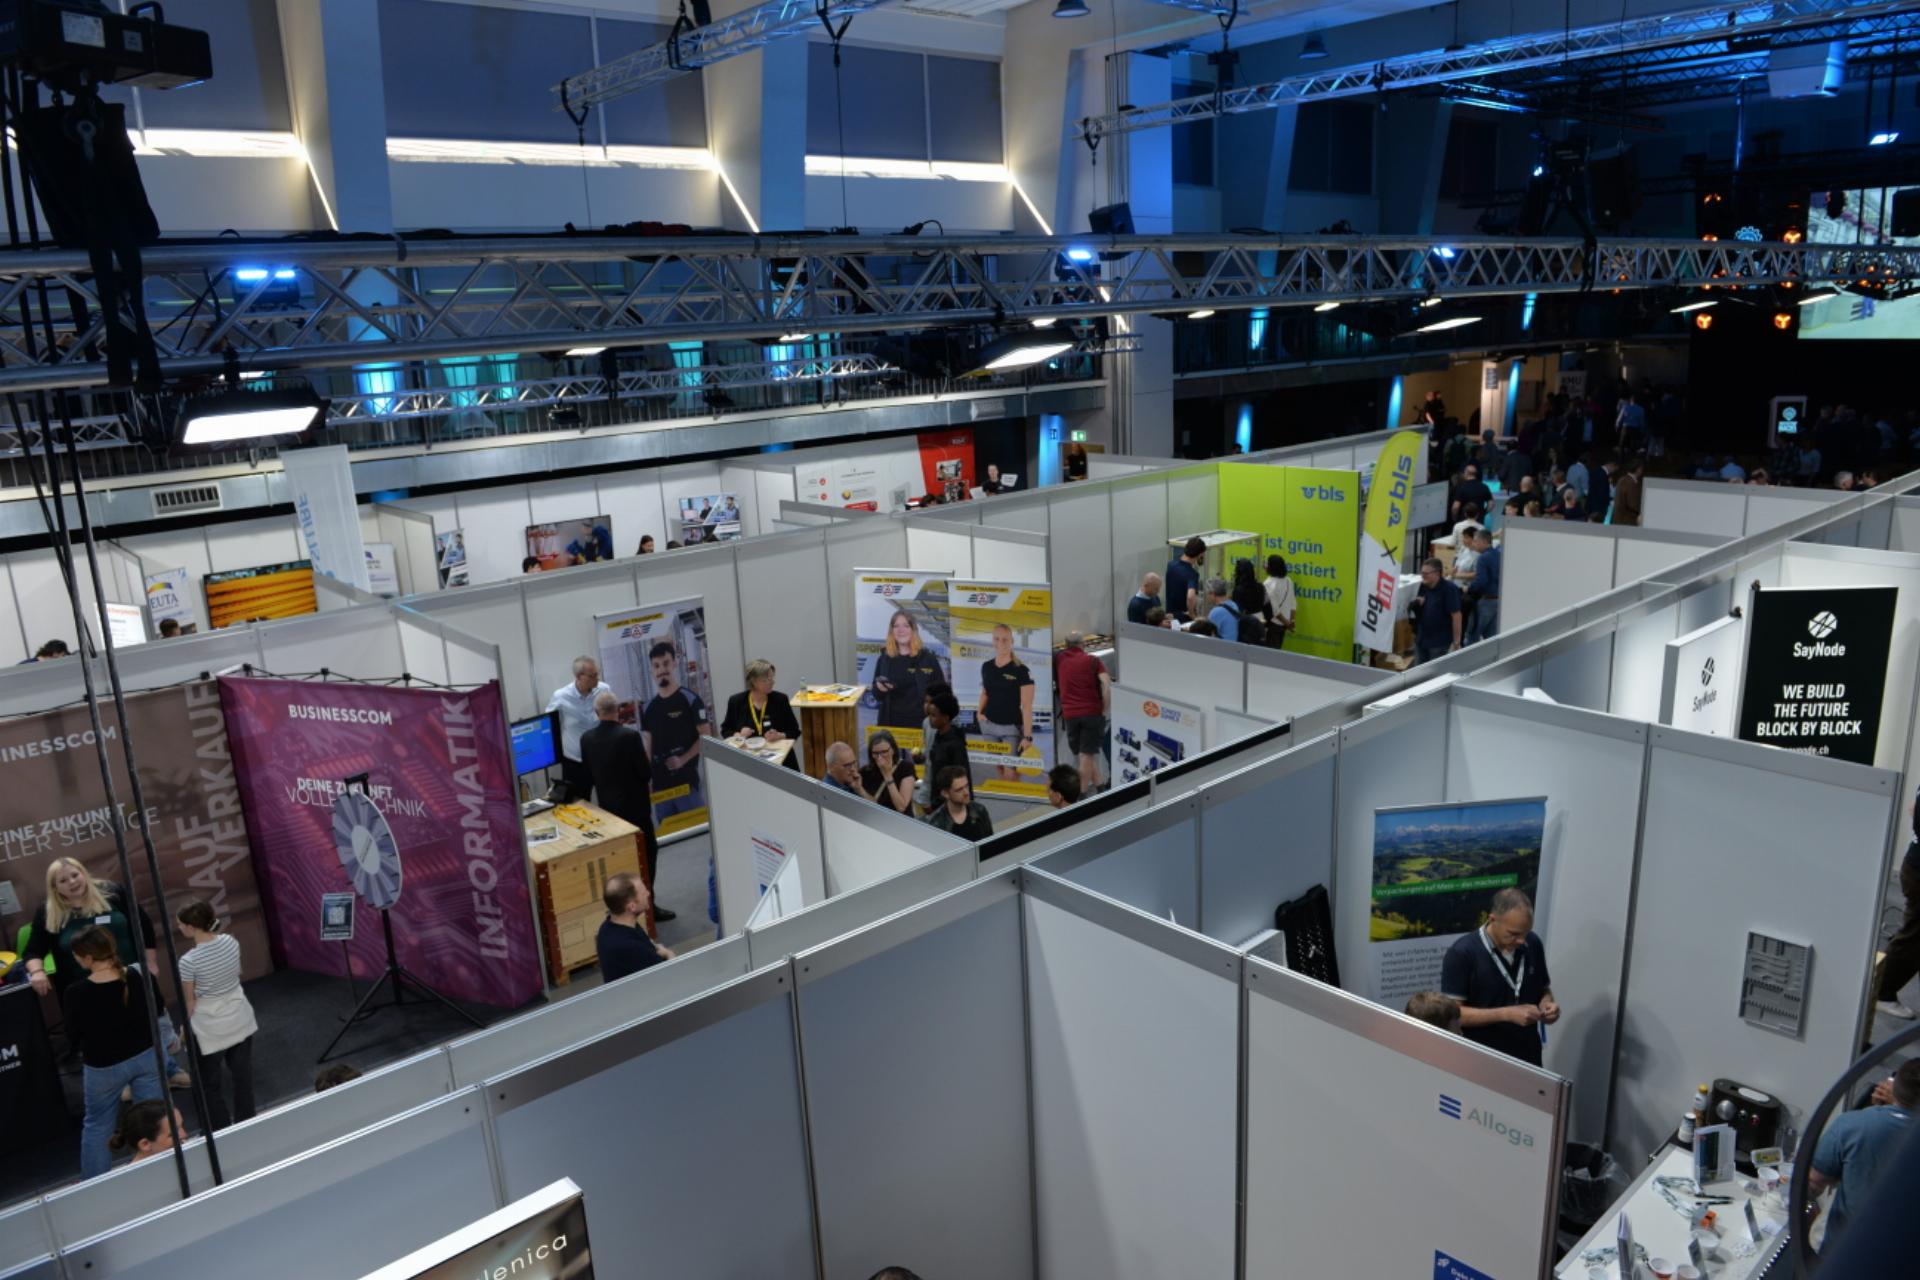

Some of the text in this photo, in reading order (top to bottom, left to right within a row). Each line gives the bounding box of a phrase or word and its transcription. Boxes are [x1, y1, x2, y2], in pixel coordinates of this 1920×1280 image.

[1389, 455, 1412, 500] bls
[1318, 485, 1345, 502] bls
[1265, 534, 1282, 549] ist
[1288, 539, 1323, 555] grün
[1294, 584, 1342, 603] kunft?
[1792, 641, 1846, 660] SayNode
[1782, 684, 1846, 699] WE BUILD
[288, 704, 393, 726] BUSINESSCOM
[1774, 702, 1850, 718] THE FUTURE
[1757, 720, 1862, 737] BLOCK BY BLOCK
[297, 777, 335, 793] DEINE
[285, 786, 336, 807] VOLLE
[441, 696, 509, 960] INFORMATIK
[1467, 1107, 1534, 1148] Alloga
[480, 1233, 568, 1280] lenica
